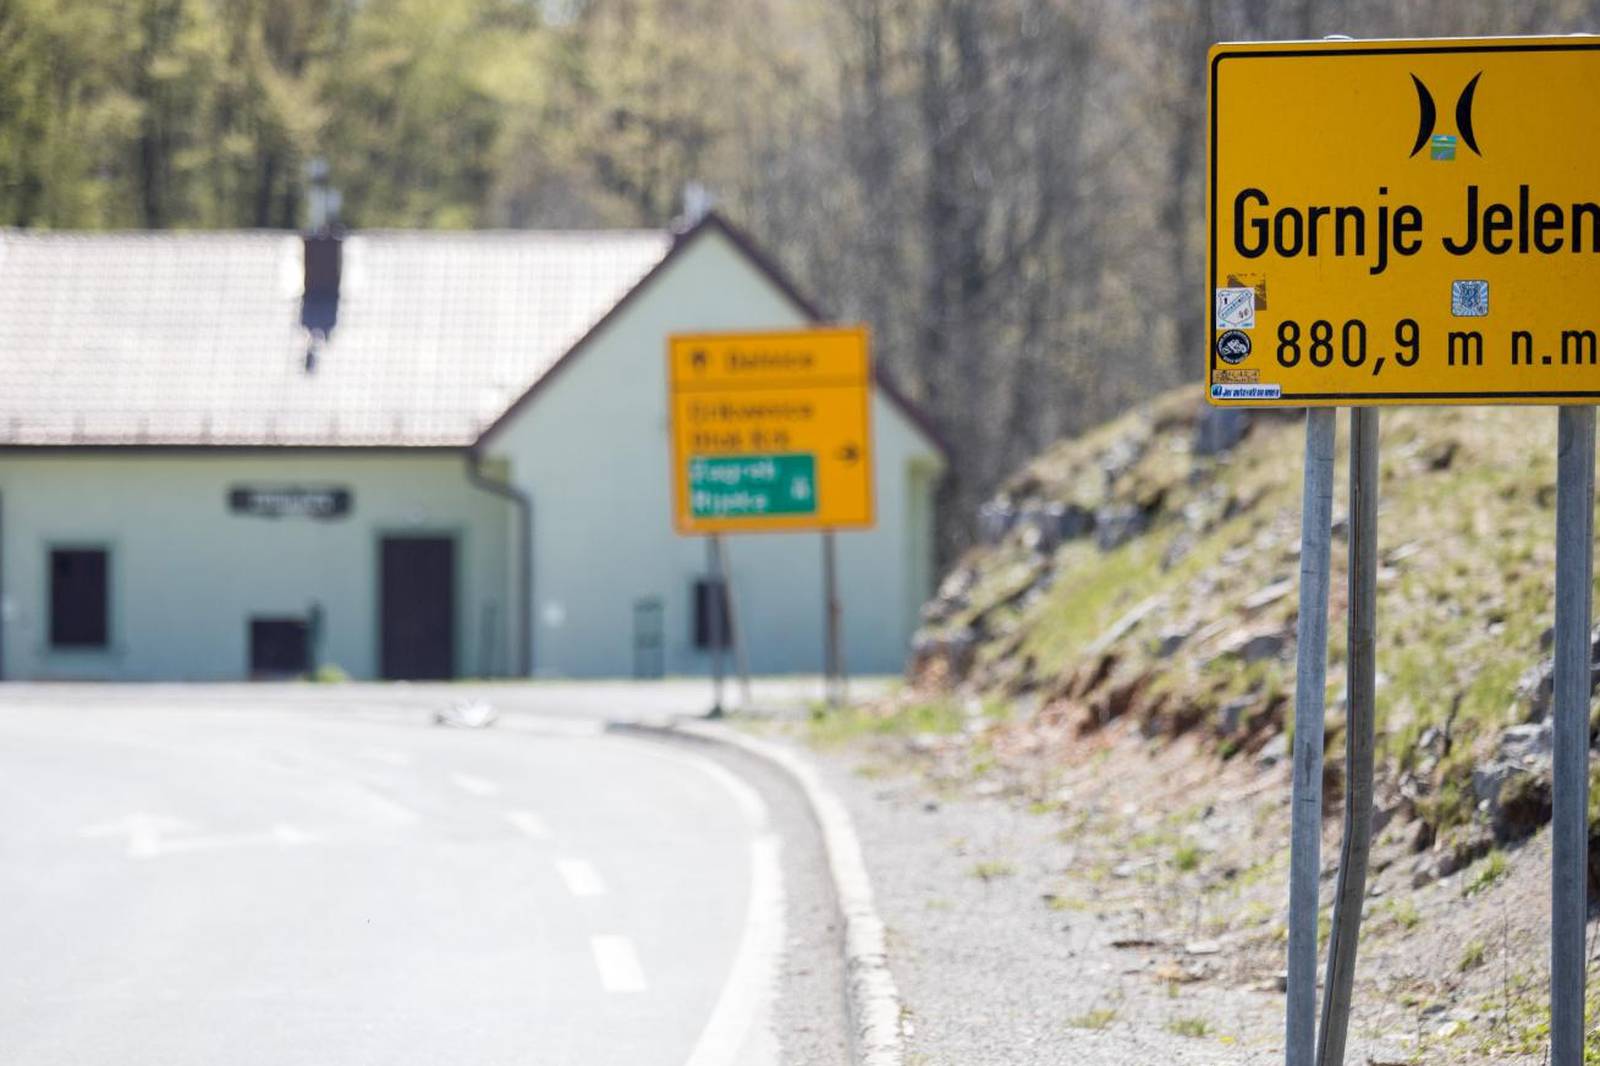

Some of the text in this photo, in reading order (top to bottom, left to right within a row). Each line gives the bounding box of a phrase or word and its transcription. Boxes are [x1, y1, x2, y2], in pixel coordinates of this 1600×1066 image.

[1233, 184, 1600, 276] Gornje Jelen
[1276, 318, 1420, 376] 880,9
[1447, 331, 1483, 366] m
